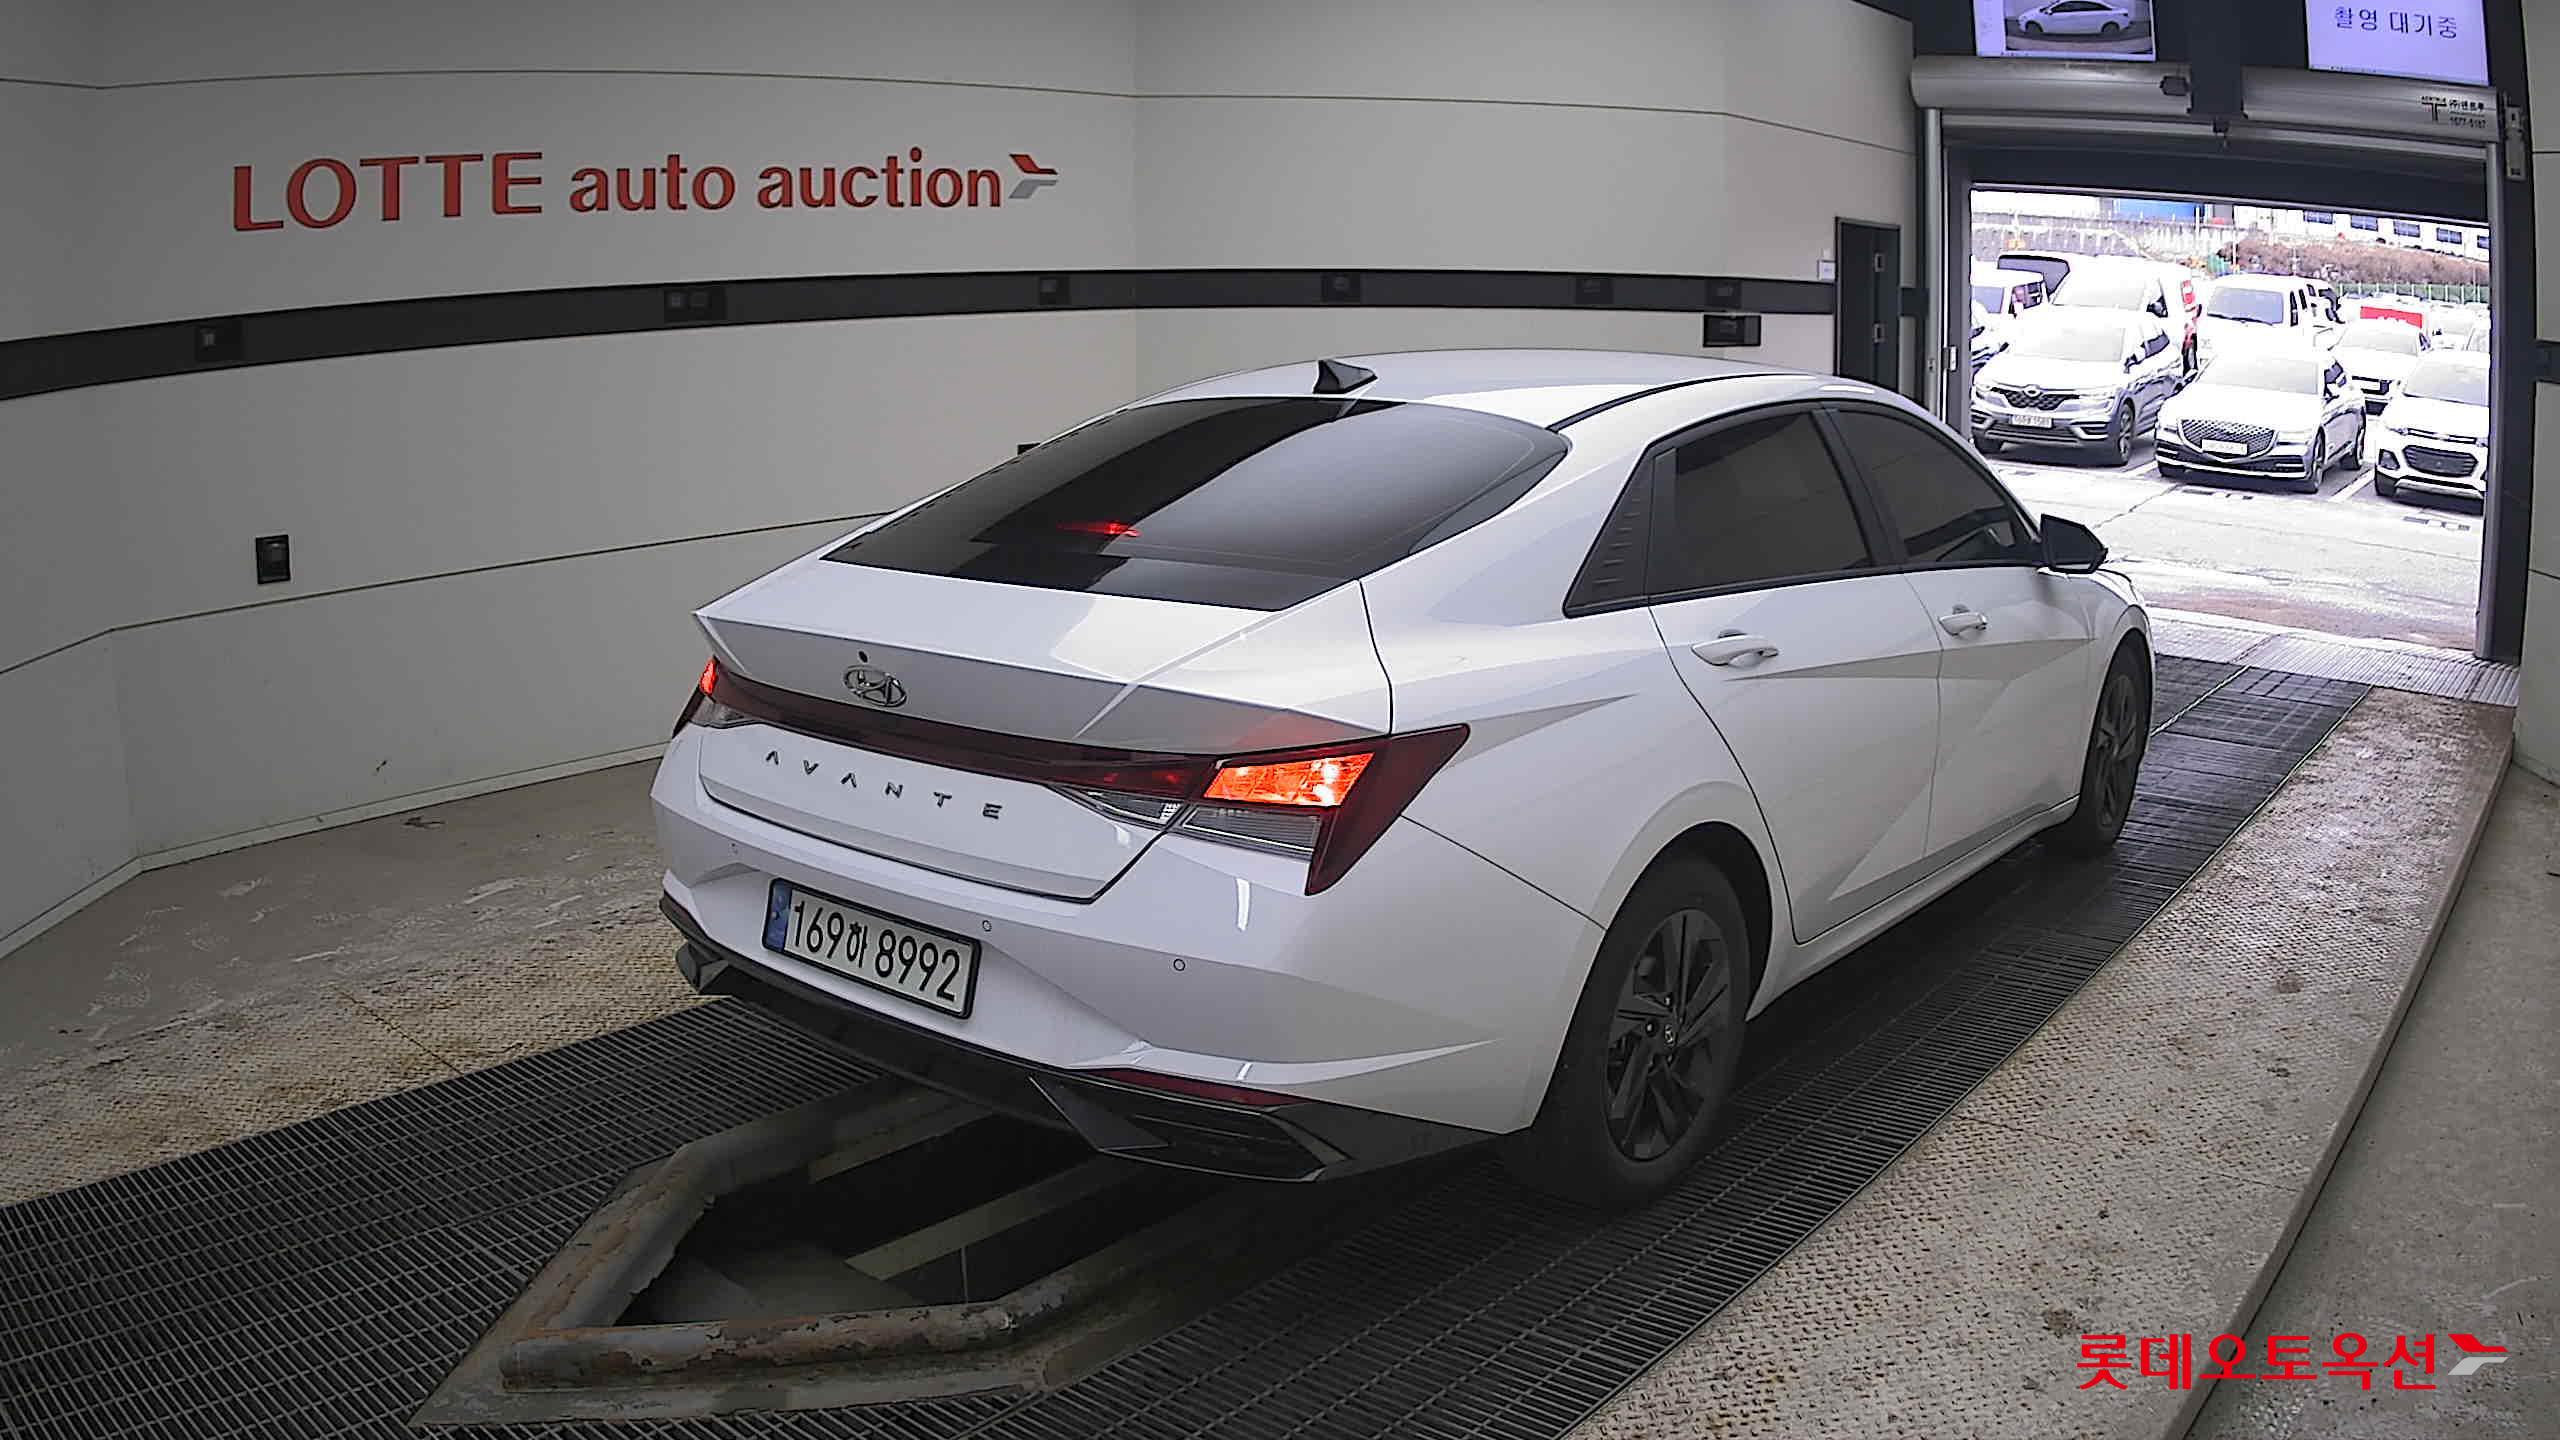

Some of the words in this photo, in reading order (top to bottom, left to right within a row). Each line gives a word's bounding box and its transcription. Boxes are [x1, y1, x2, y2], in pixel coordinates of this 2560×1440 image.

[2335, 7, 2378, 31] 촬영
[233, 152, 543, 232] LOTTE
[569, 154, 735, 212] auto
[757, 147, 1002, 209] auction
[765, 750, 1002, 819] AVANTE
[793, 901, 868, 968] 169하
[874, 929, 961, 1002] 8992
